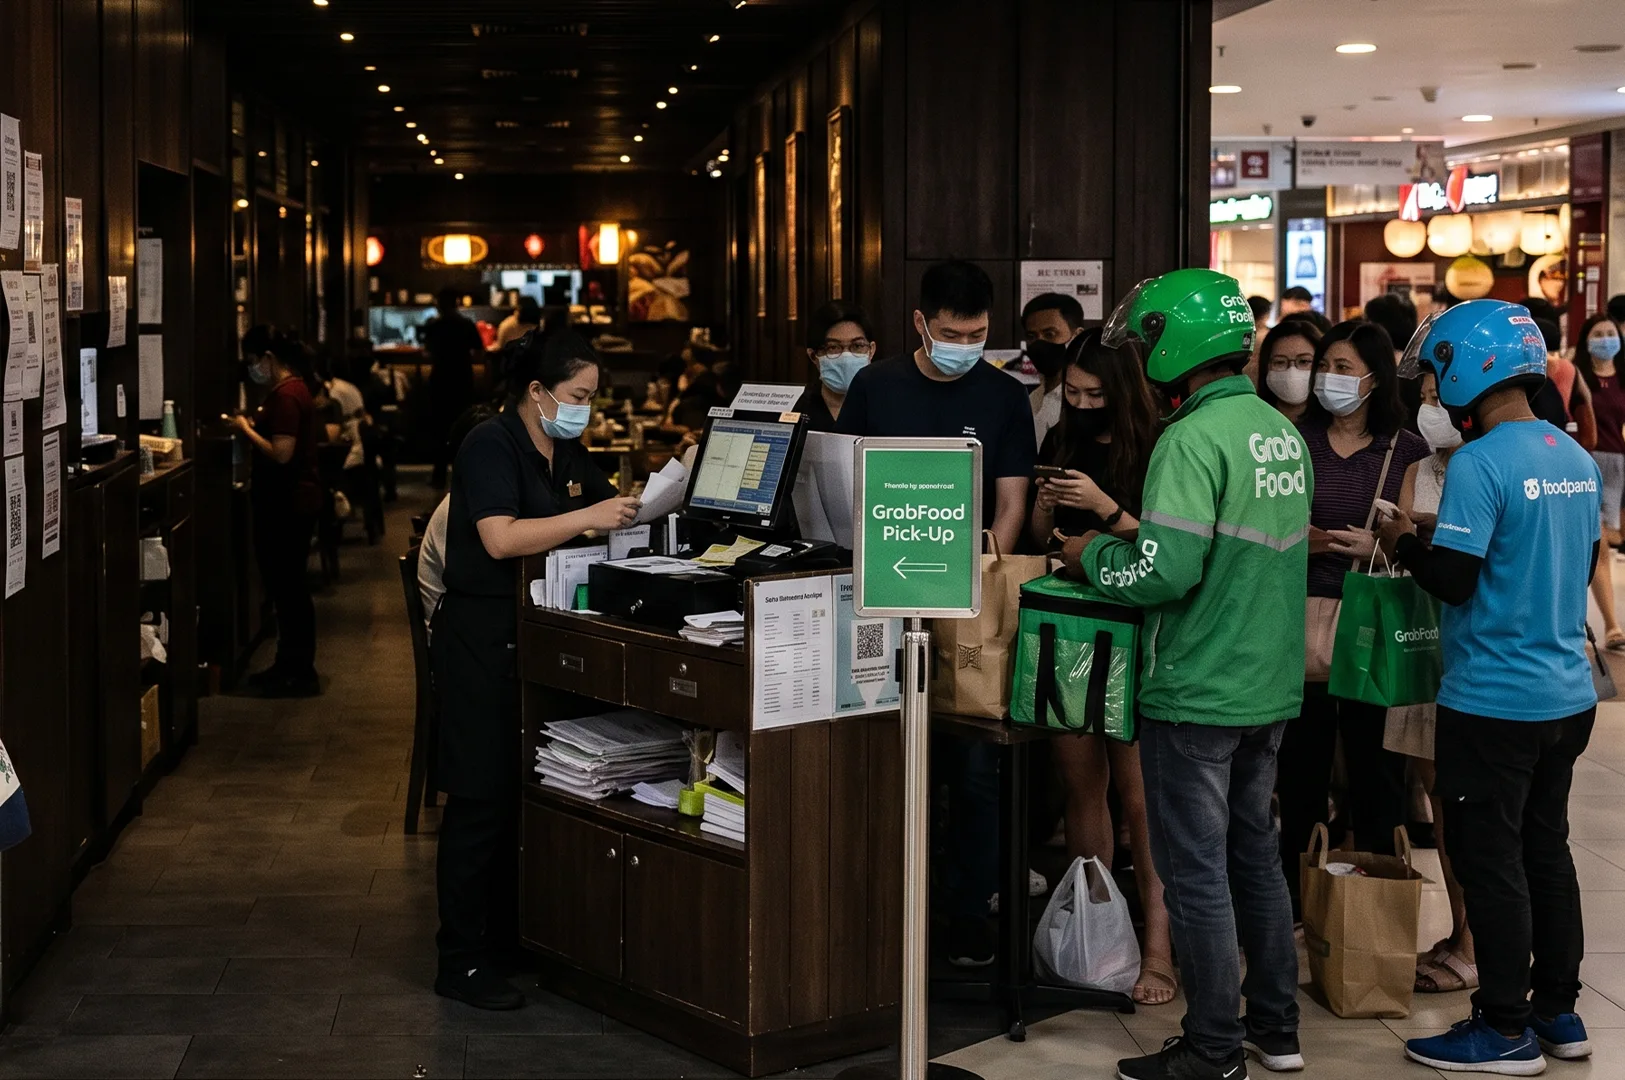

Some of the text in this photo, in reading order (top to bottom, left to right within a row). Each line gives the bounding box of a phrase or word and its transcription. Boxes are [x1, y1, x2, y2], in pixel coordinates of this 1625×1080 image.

[1220, 294, 1247, 308] Gra
[1248, 428, 1302, 463] Grab
[1255, 463, 1306, 499] Food
[1542, 477, 1597, 498] foodpanda
[872, 503, 965, 520] GrabFood
[883, 524, 955, 545] Pick-Up
[1394, 626, 1439, 643] GrabFood
